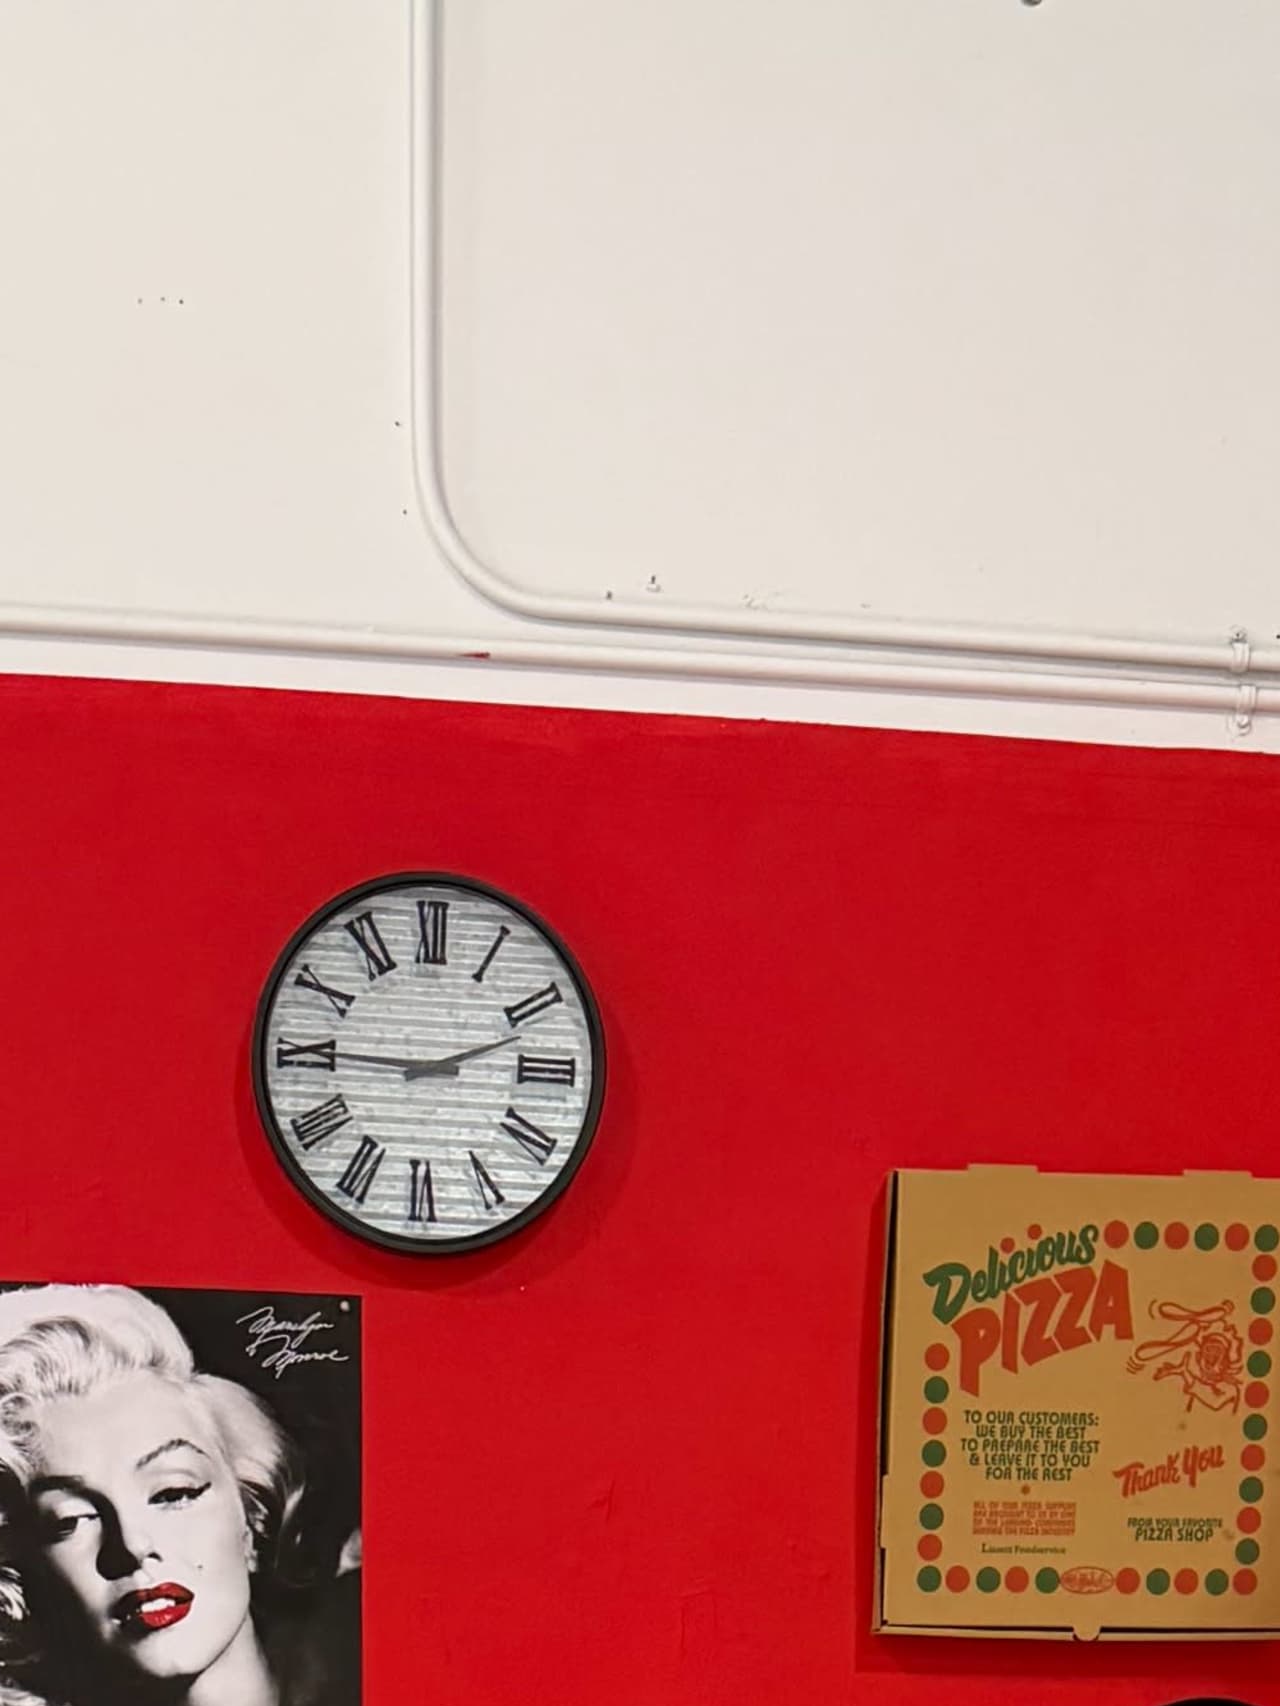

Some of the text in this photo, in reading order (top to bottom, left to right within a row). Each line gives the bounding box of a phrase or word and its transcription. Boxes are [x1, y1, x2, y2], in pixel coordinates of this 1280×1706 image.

[344, 911, 397, 981] XI
[415, 900, 449, 965] XII
[294, 964, 356, 1018] X
[504, 982, 563, 1027] II
[277, 1037, 336, 1072] IX
[517, 1054, 575, 1087] III
[290, 1093, 354, 1150] VIII
[499, 1106, 557, 1166] IV
[336, 1135, 386, 1204] VII
[409, 1159, 437, 1222] VI
[468, 1150, 506, 1210] V
[922, 1224, 1099, 1325] Delicious
[951, 1259, 1134, 1397] PIZZA
[964, 1410, 1099, 1427] TO OUR CUSTOMERS:
[976, 1425, 1086, 1439] WE BUY THE BEST
[960, 1438, 1100, 1454] TO PREPARE THE BEST
[969, 1453, 1090, 1467] & LEAVE IT TO YOU
[1112, 1445, 1225, 1498] Thank You
[985, 1467, 1072, 1481] FOR THE REST
[1136, 1528, 1213, 1541] PIZZA SHOP
